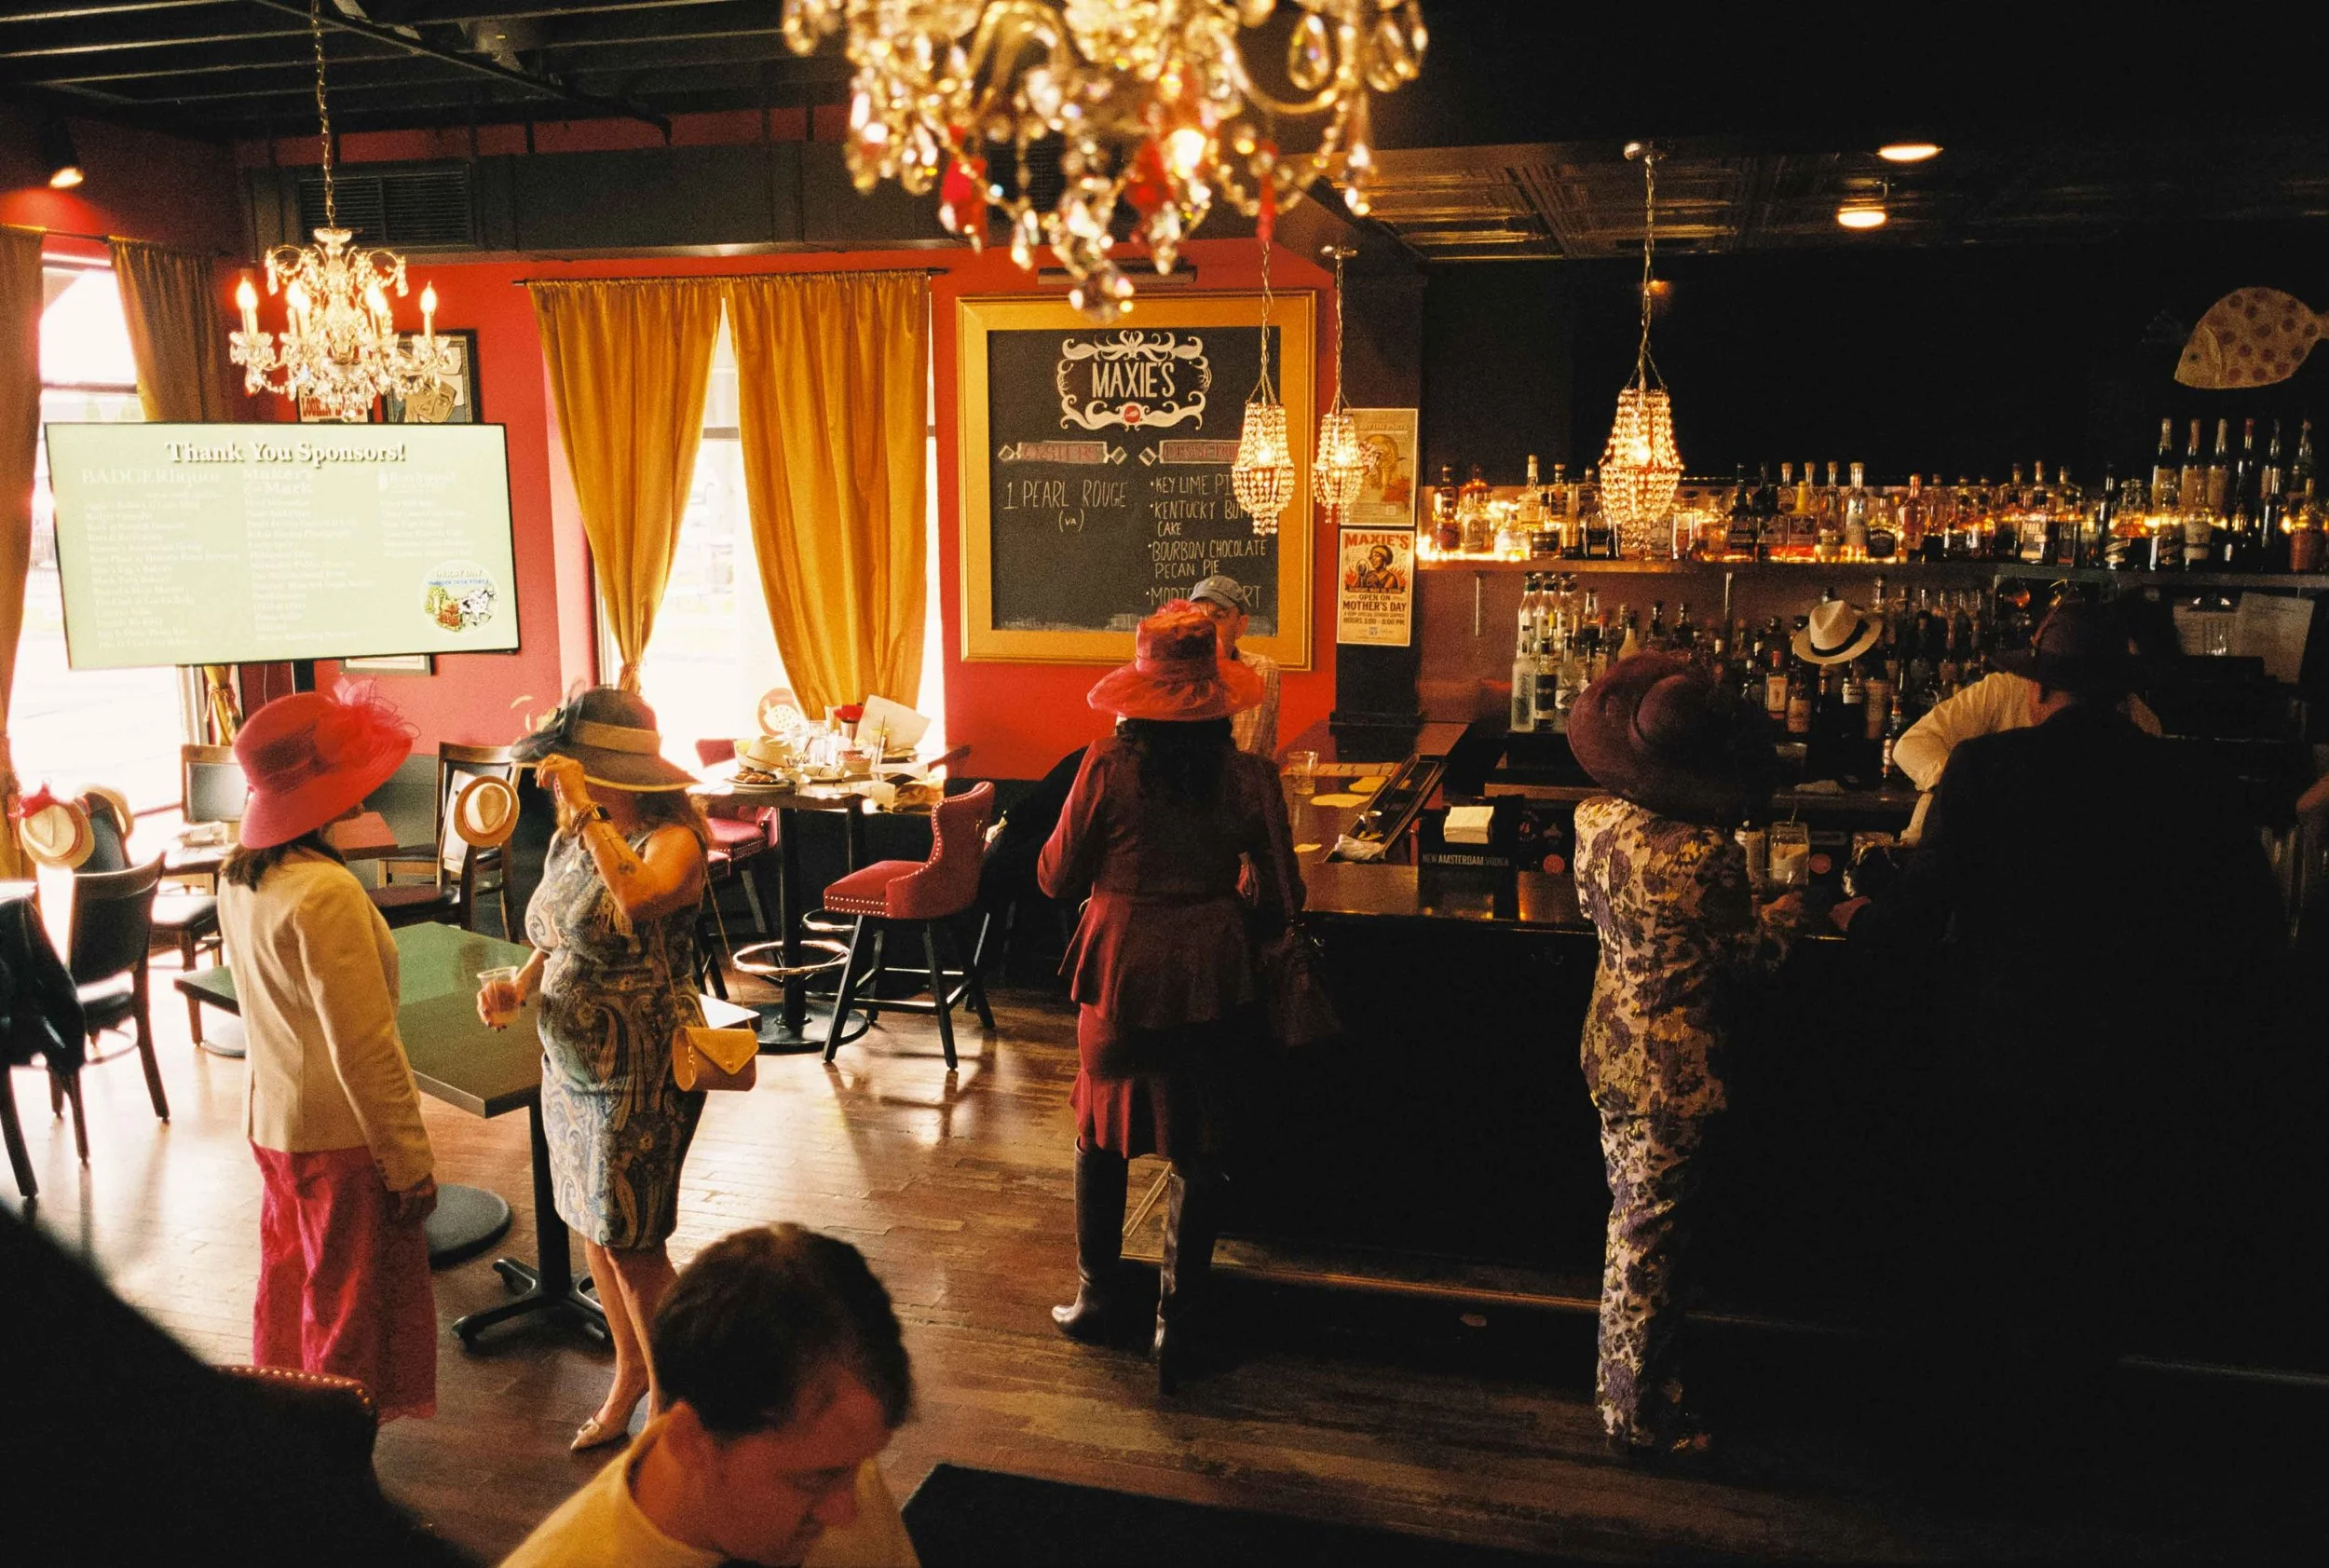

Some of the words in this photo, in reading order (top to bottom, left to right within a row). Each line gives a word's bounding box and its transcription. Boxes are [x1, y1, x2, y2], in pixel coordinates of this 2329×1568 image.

[1091, 361, 1176, 399] MAXIE'S
[166, 442, 244, 463] Thank
[249, 442, 293, 462] You
[299, 442, 407, 469] Sponsors!
[266, 481, 314, 495] Mark
[1002, 481, 1019, 510] 1
[1023, 480, 1069, 509] PEARL
[1082, 478, 1129, 509] ROUGE
[1155, 476, 1175, 495] KEY
[1178, 474, 1208, 495] LIME
[1215, 473, 1232, 496] PI
[1058, 508, 1085, 533] (VA)
[1154, 500, 1216, 521] KENTUCKY
[1157, 521, 1182, 538] CAKE
[1151, 539, 1205, 562] BOURBON
[1209, 539, 1268, 560] CHOCOLATE
[1344, 532, 1410, 551] MAXIE'S
[1154, 563, 1195, 579] PECAN
[1203, 558, 1220, 578] PIE
[1342, 601, 1388, 611] MOTHER'S
[1390, 602, 1407, 612] DAY
[1422, 852, 1438, 864] NEW
[1438, 853, 1484, 866] AMSTERDAM
